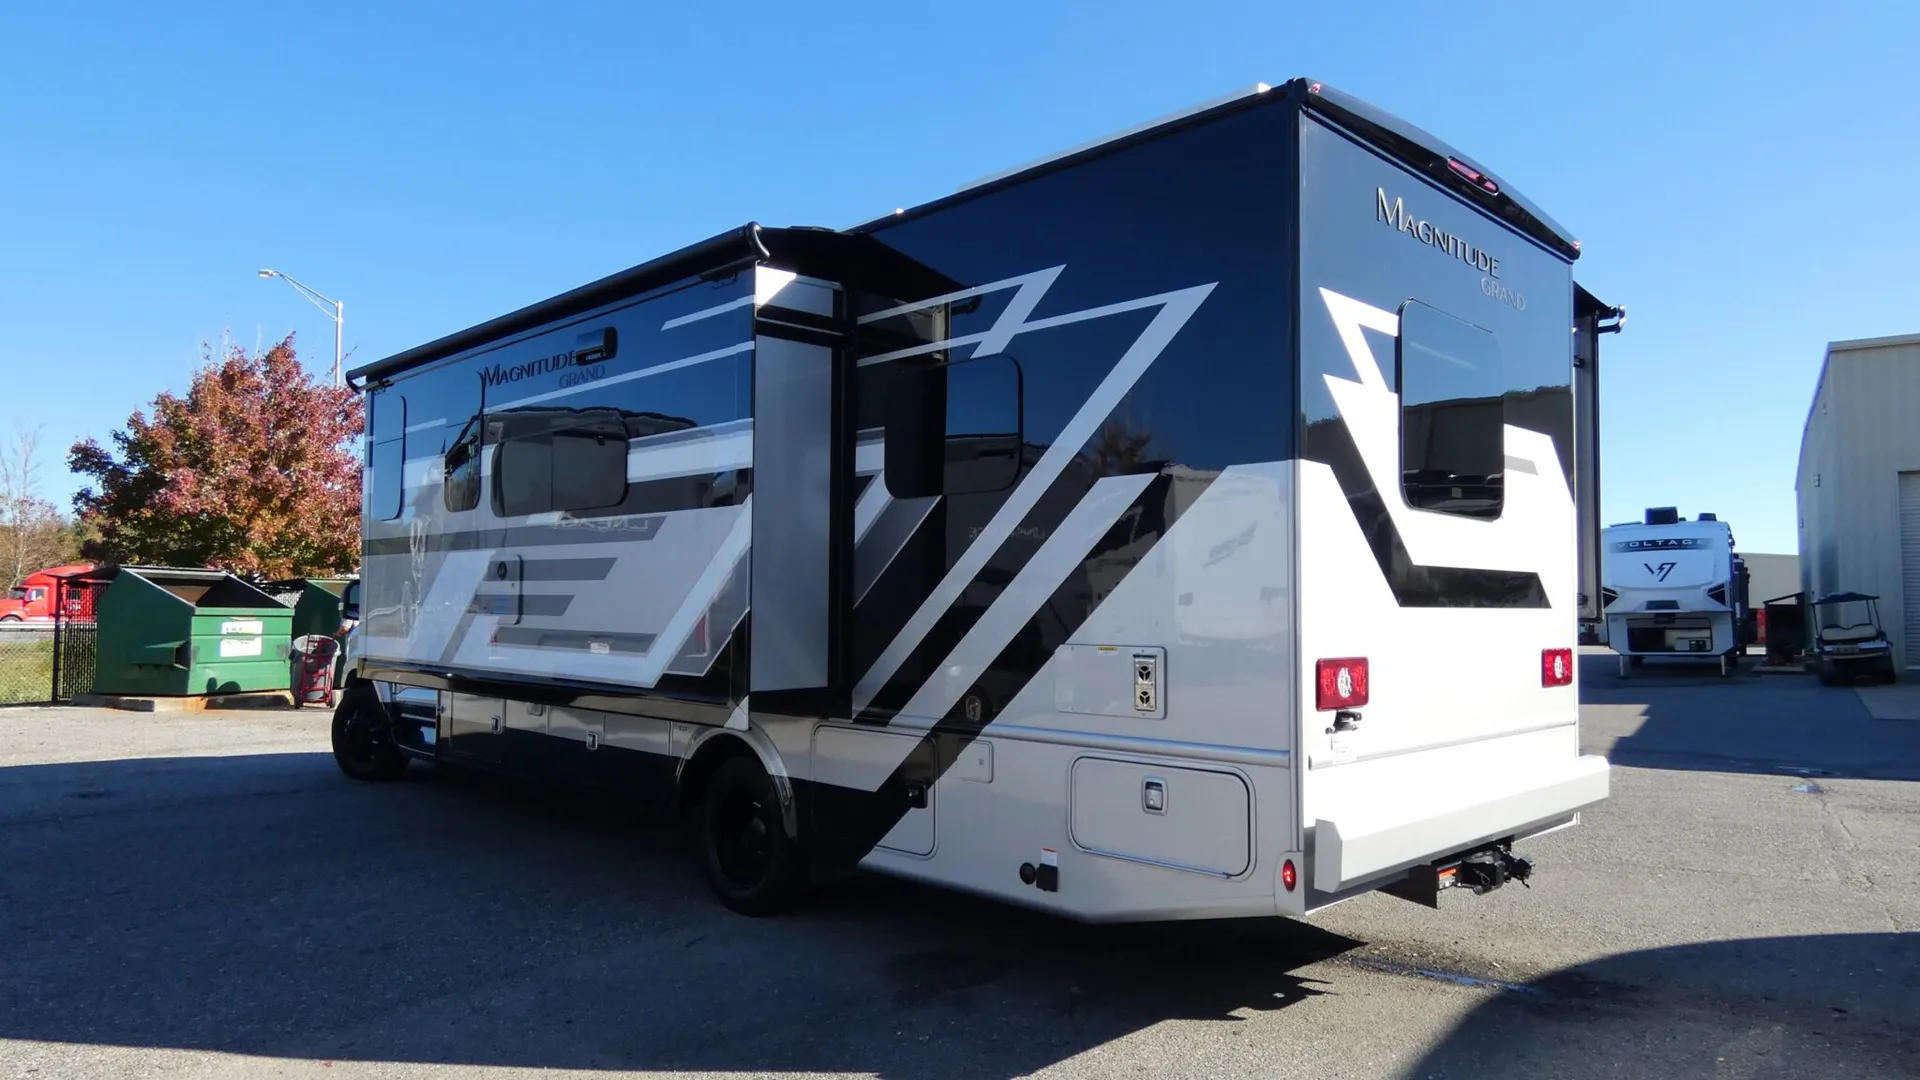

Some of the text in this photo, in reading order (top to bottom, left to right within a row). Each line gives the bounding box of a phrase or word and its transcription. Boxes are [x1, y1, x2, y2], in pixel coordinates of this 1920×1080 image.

[1376, 186, 1500, 280] MAGNITUDE
[1480, 276, 1526, 311] GRAND
[484, 350, 577, 387] MAGNITUDE
[559, 365, 606, 389] GRAND
